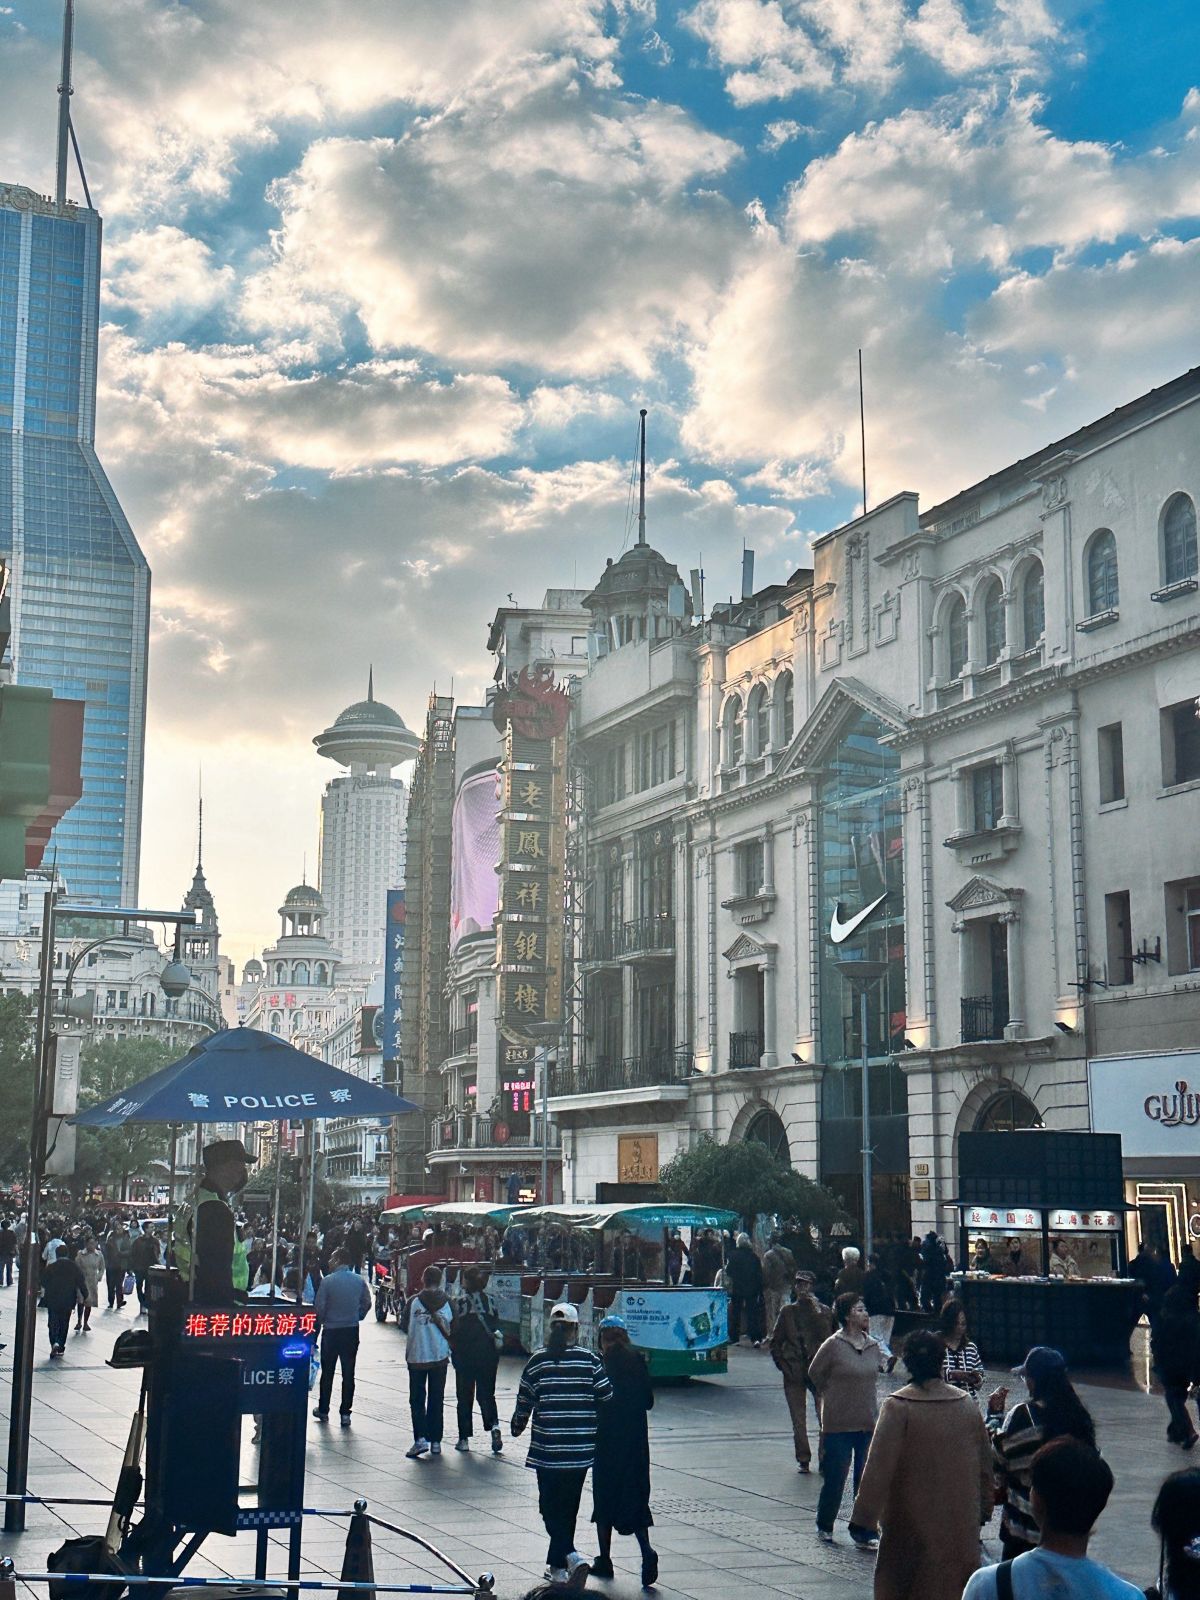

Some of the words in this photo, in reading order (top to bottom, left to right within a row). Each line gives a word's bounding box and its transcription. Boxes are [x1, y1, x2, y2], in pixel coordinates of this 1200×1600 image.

[187, 1092, 210, 1108] 警
[223, 1093, 318, 1109] POLICE
[329, 1088, 352, 1103] 察
[185, 1313, 317, 1337] 推荐的旅游项
[278, 1368, 295, 1385] 察
